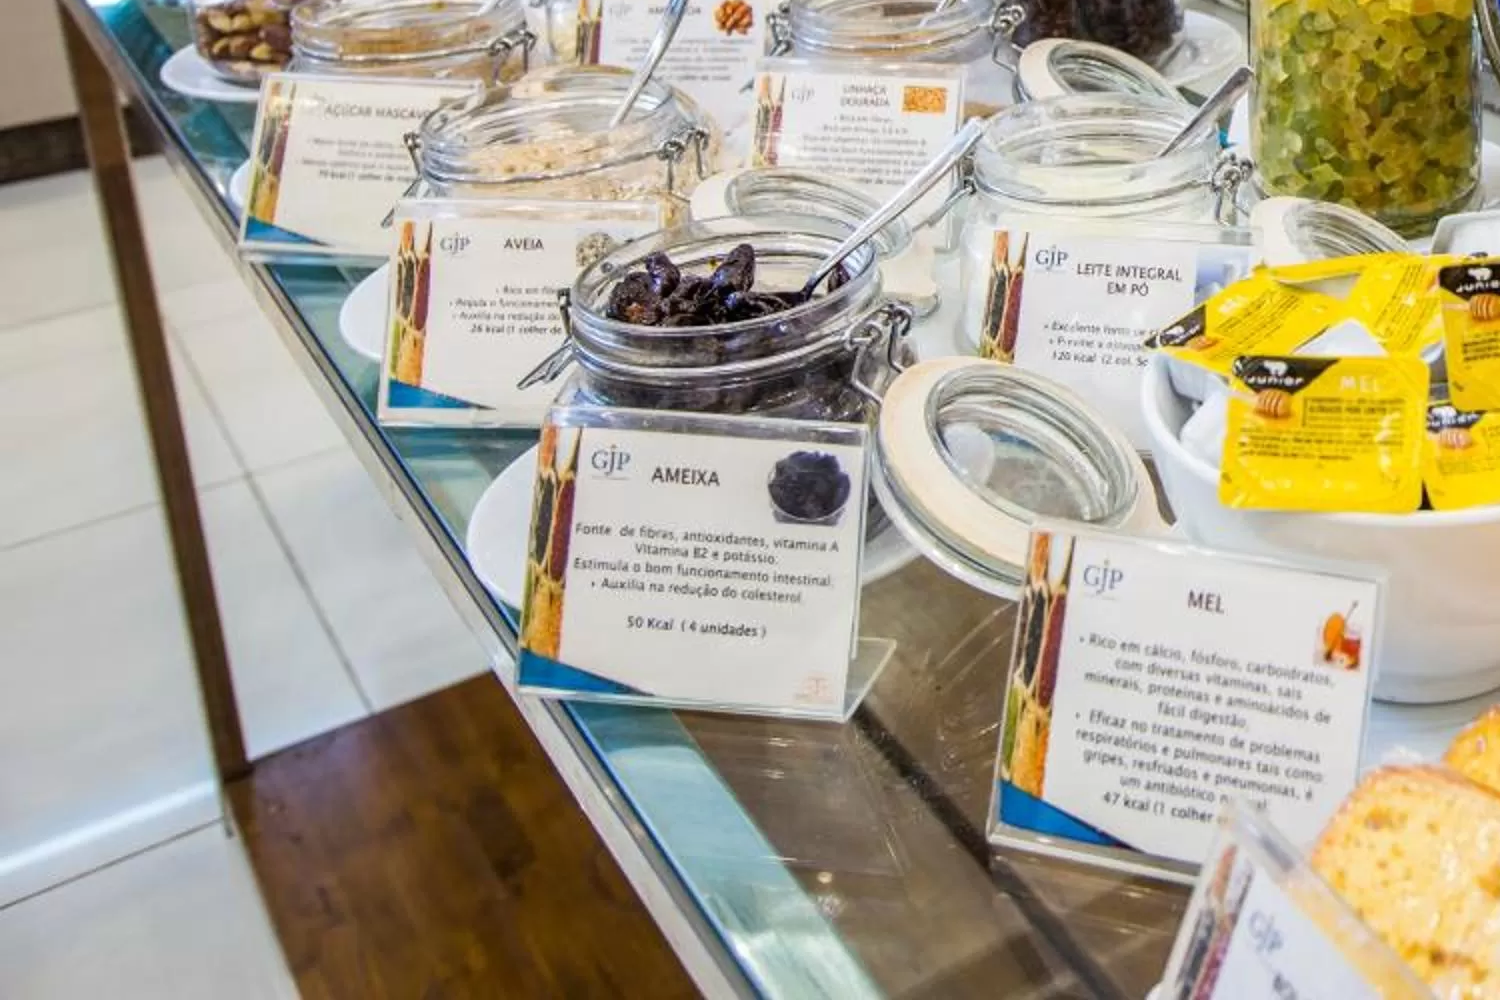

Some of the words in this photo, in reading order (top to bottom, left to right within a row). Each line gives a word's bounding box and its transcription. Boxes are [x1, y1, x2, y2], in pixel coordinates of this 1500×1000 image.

[504, 238, 544, 250] AVEIA
[1077, 264, 1112, 277] LEITE
[1116, 266, 1182, 282] INTEGRAL
[1107, 282, 1126, 294] EM
[1130, 281, 1149, 297] PÓ
[651, 467, 720, 487] AMEIXA
[576, 522, 612, 536] Fonte
[620, 524, 635, 537] de
[640, 525, 678, 541] fibras,
[683, 530, 769, 549] antioxidantes,
[773, 538, 827, 552] vitamina
[830, 540, 839, 552] A
[635, 543, 689, 558] Vitamina
[712, 550, 719, 560] e
[574, 557, 629, 572] Estimula
[633, 564, 640, 572] o
[645, 562, 673, 574] bom
[677, 564, 769, 582] funcionamento
[601, 578, 645, 592] Auxilia
[649, 582, 664, 592] na
[668, 583, 719, 598] redução
[722, 586, 737, 599] do
[1188, 590, 1224, 614] MEL
[627, 616, 644, 629] 50
[700, 623, 758, 637] unidades
[1089, 632, 1117, 650] Rico
[1120, 641, 1140, 653] em
[1115, 658, 1142, 672] com
[1147, 662, 1200, 682] diversas
[1278, 686, 1302, 700] sais
[1215, 694, 1222, 705] e
[1314, 710, 1332, 724] de
[1089, 708, 1127, 728] Eficaz
[1131, 720, 1148, 733] no
[1152, 723, 1224, 746] tratamento
[1230, 736, 1245, 749] de
[1250, 742, 1320, 764] problemas
[1076, 728, 1158, 754] respiratórios
[1162, 745, 1169, 756] e
[1173, 746, 1252, 770] pulmonares
[1257, 760, 1280, 776] tais
[1284, 767, 1323, 783] como
[1132, 758, 1198, 780] resfriados
[1202, 772, 1210, 782] e
[1120, 776, 1141, 789] um
[1144, 780, 1215, 803] antibiótico
[1103, 792, 1120, 805] 47
[1124, 794, 1150, 812] kcal
[1171, 806, 1214, 823] colher
